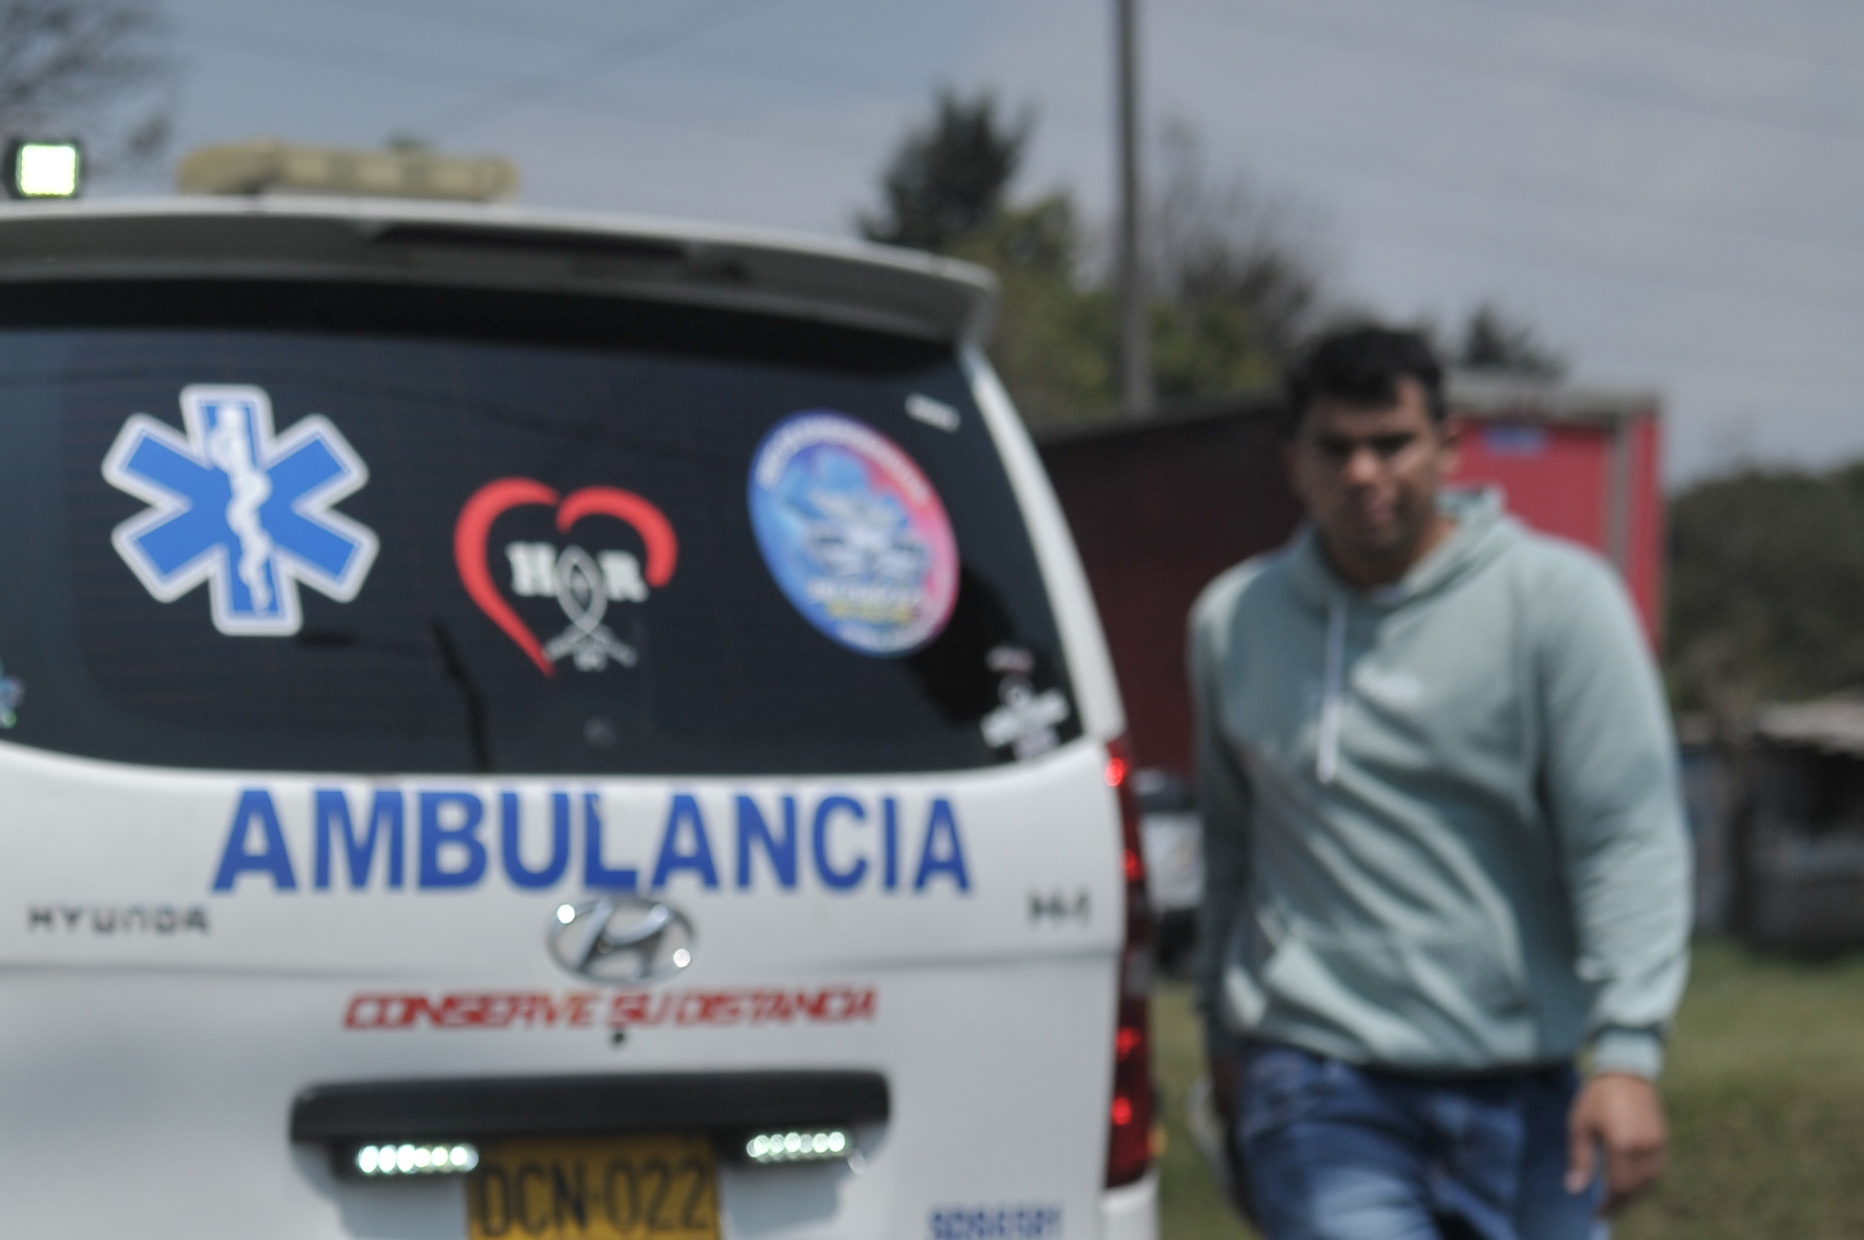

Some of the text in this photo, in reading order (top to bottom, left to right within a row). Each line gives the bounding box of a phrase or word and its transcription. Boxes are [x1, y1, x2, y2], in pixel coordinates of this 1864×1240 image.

[210, 786, 973, 894] AMBULANCIA
[343, 993, 594, 1029] CONSERVE
[608, 994, 672, 1026] SU
